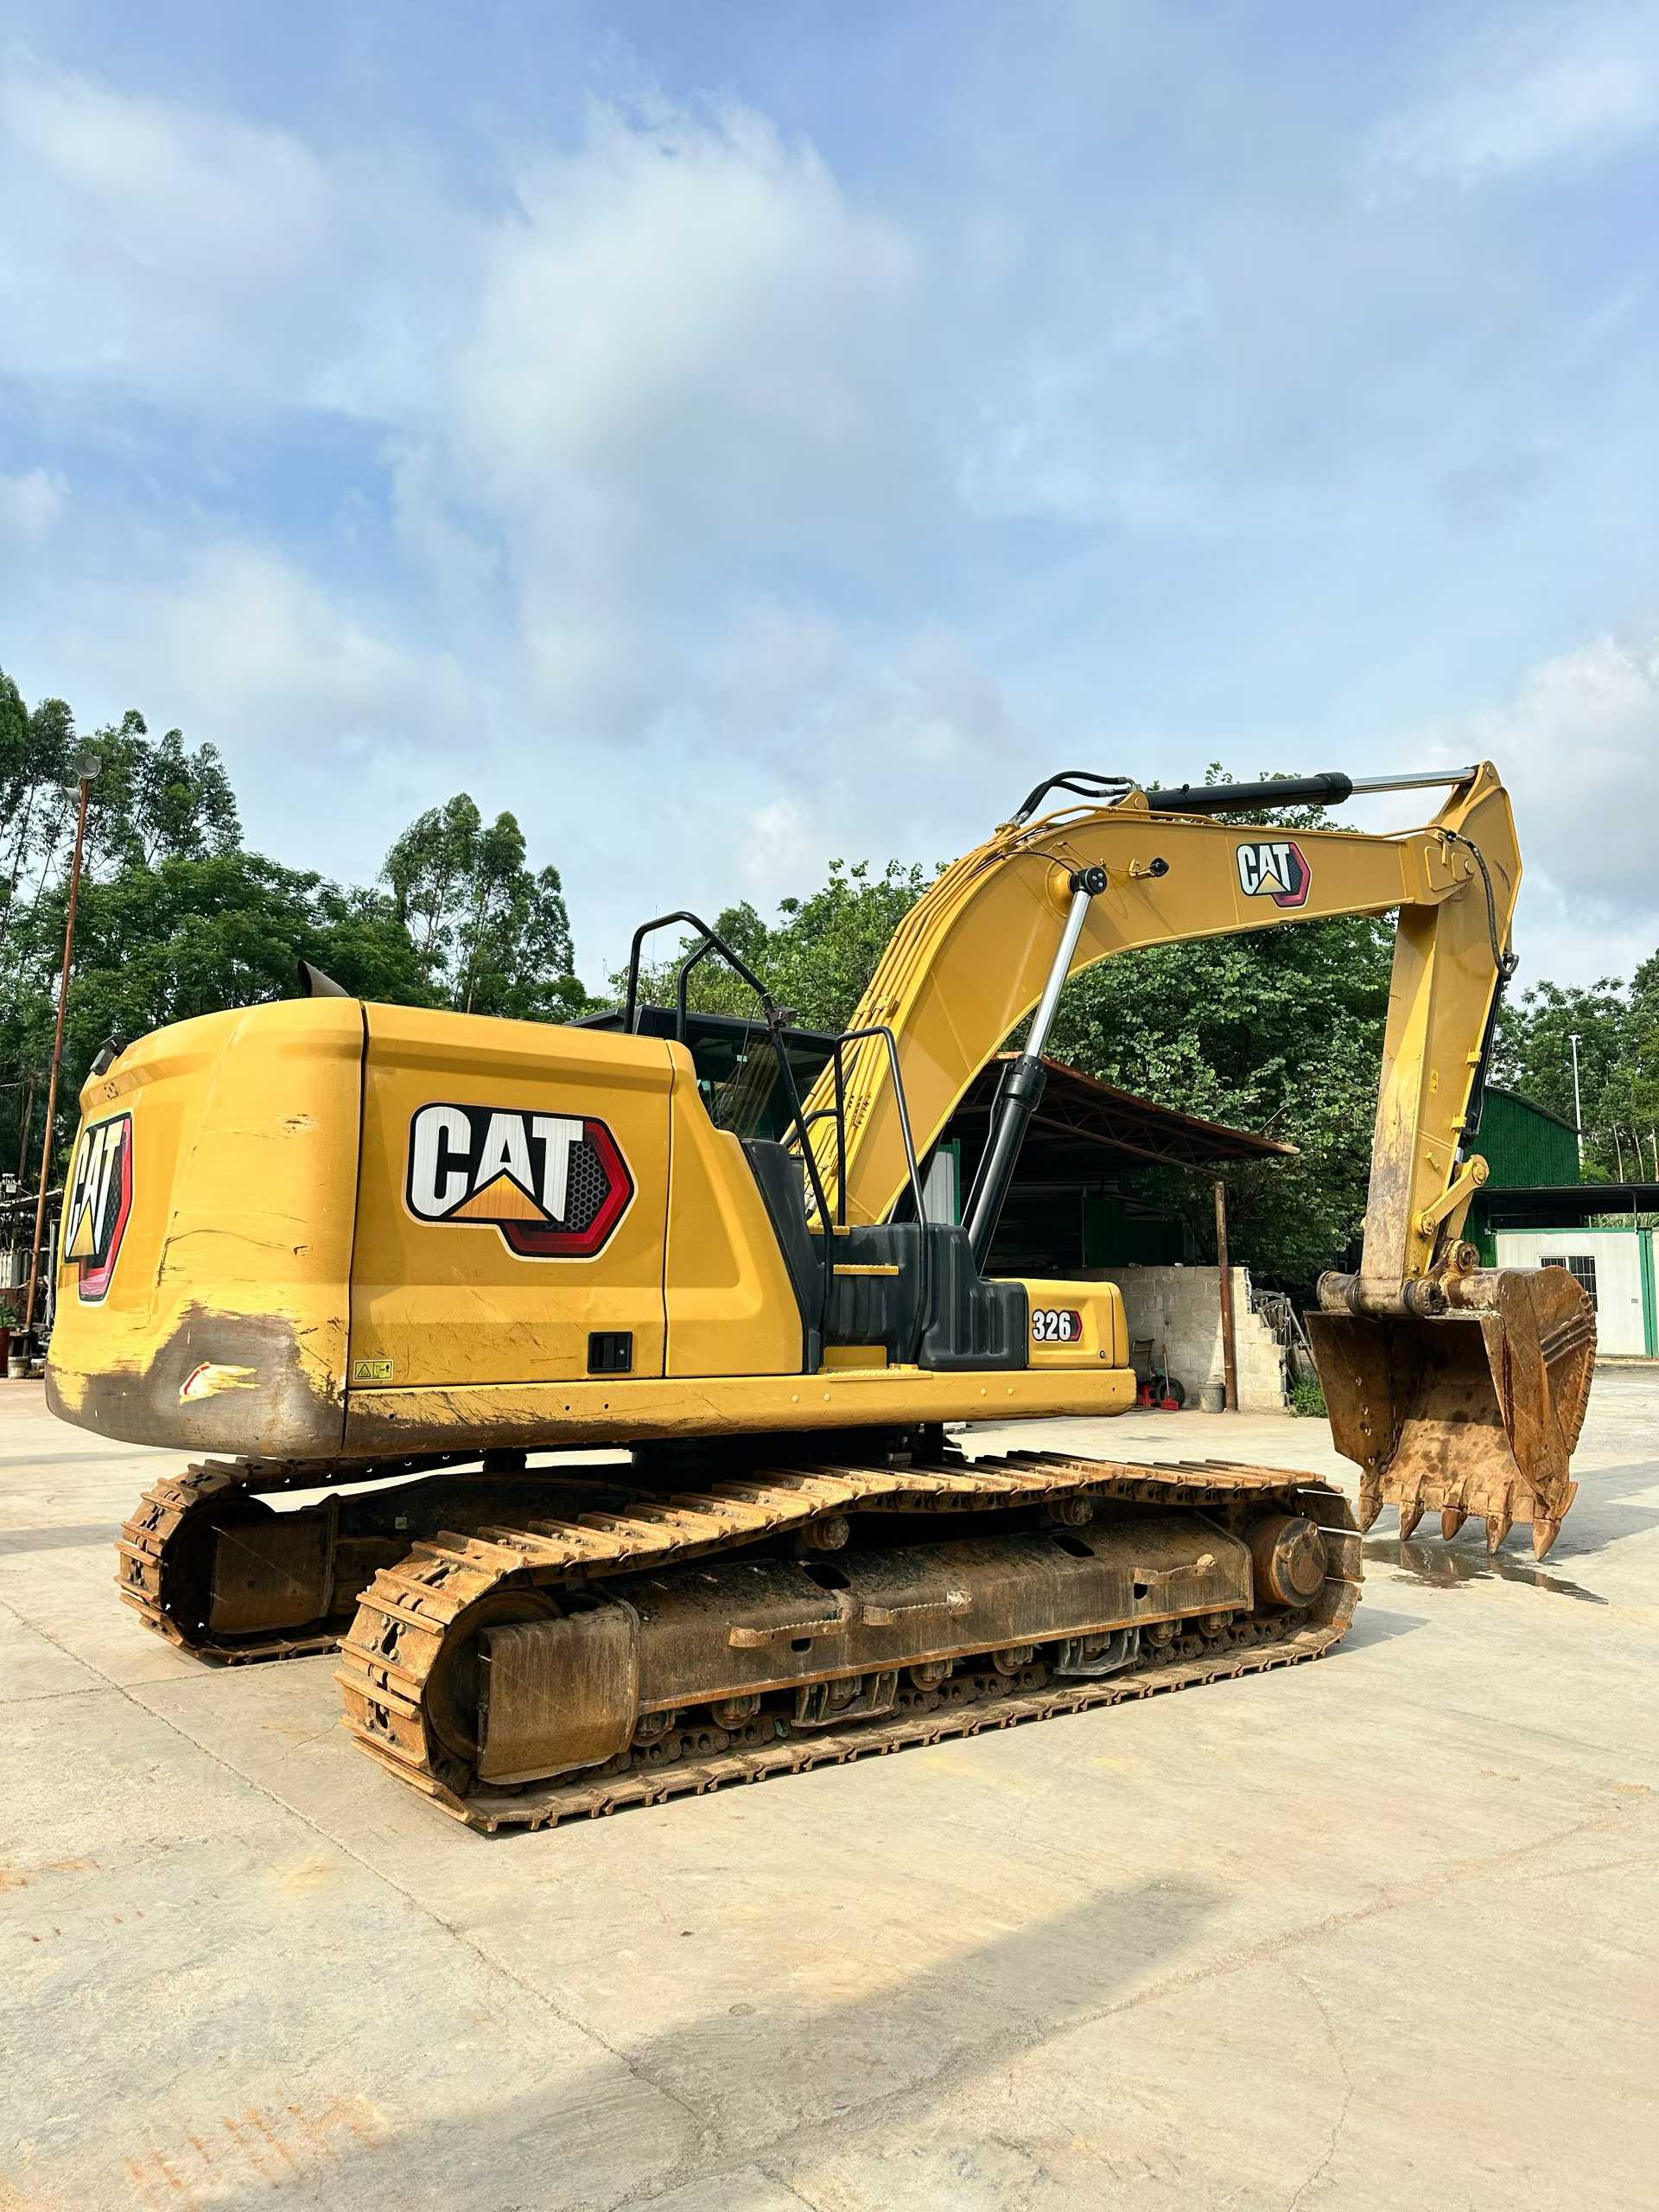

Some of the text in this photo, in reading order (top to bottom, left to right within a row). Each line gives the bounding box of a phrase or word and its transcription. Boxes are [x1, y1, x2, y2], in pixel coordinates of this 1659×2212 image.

[1238, 844, 1291, 894] CAT
[66, 1119, 124, 1255] CAT
[412, 1106, 584, 1222] CAT
[1033, 1311, 1071, 1340] 326
